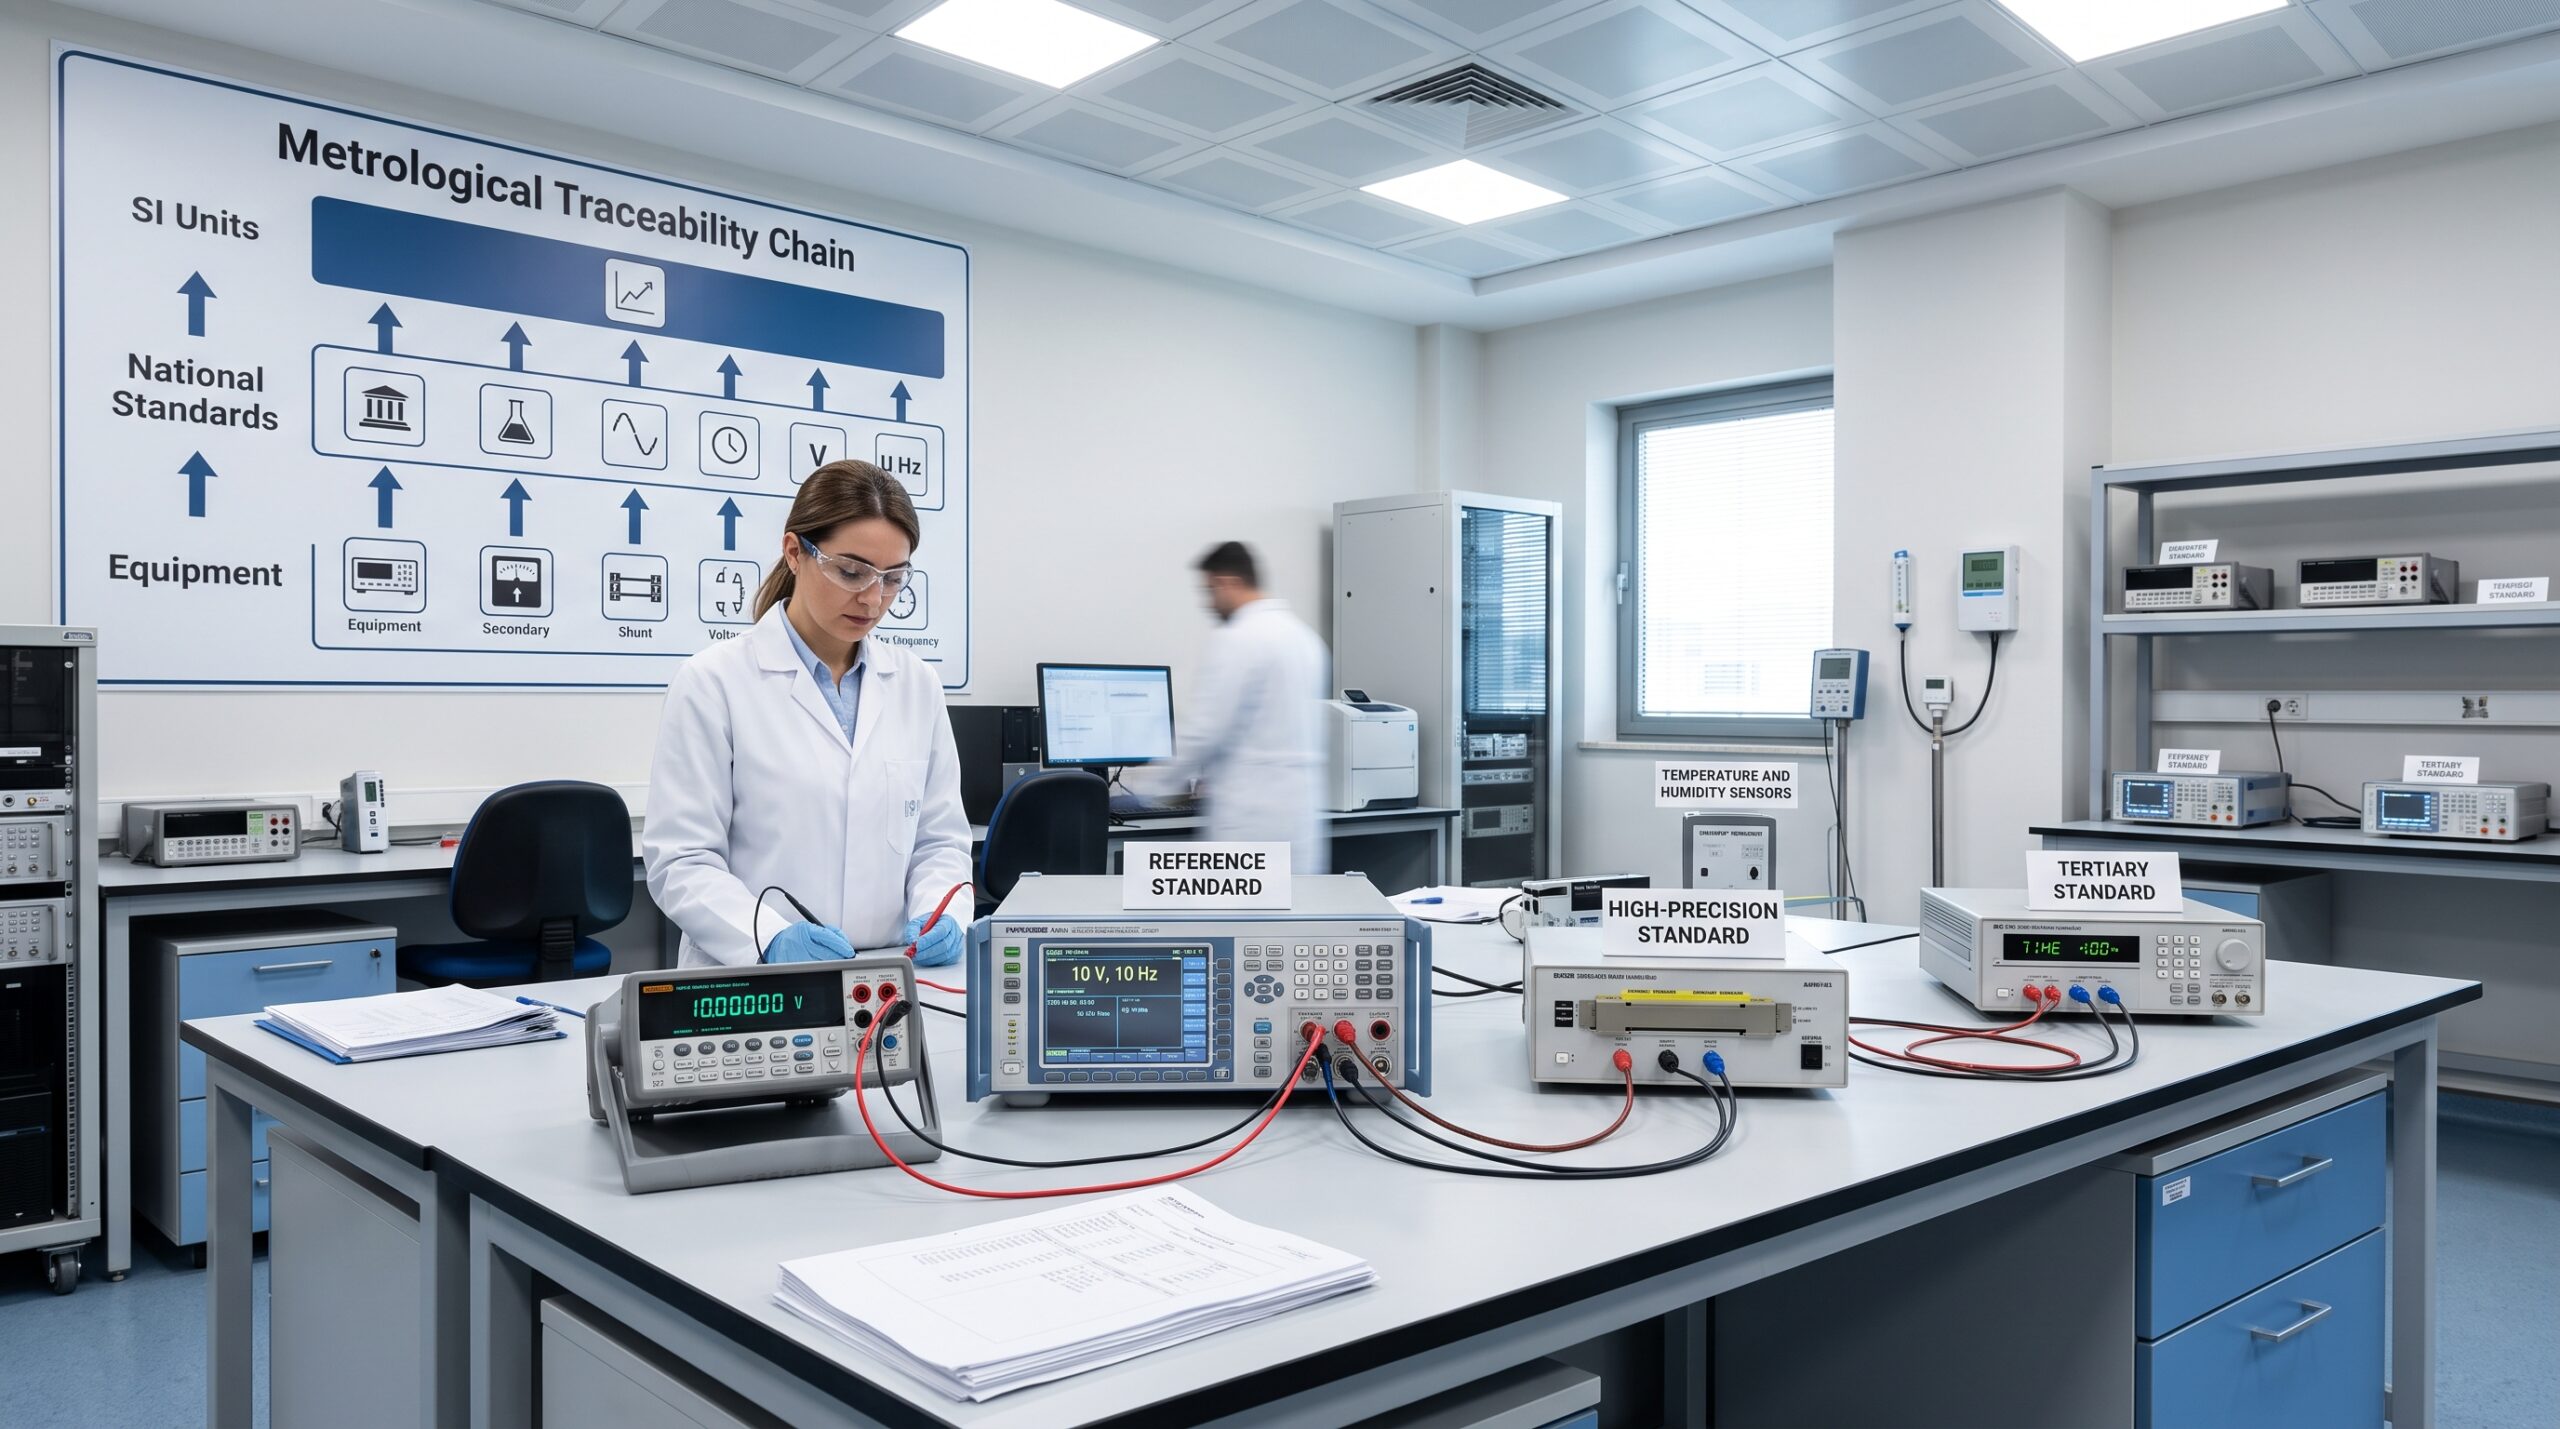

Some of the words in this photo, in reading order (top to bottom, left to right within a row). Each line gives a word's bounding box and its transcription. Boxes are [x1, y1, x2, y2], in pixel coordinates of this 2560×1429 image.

[278, 123, 543, 209] Metrological
[554, 181, 758, 260] Traceability
[769, 227, 855, 271] Chain
[131, 196, 162, 225] SI
[175, 202, 260, 241] Units
[128, 353, 263, 392] National
[112, 391, 279, 431] Standards
[809, 444, 827, 467] V
[109, 554, 283, 590] Equipment
[348, 618, 422, 634] Equipment
[482, 622, 550, 639] Secondary
[618, 626, 653, 639] Shunt
[1661, 769, 1759, 782] TEMPERATURE
[1762, 770, 1791, 782] AND
[1660, 786, 1726, 799] HUMIDITY
[1729, 786, 1792, 800] SENSORS
[1149, 852, 1266, 870] REFERENCE
[2057, 860, 2149, 877] TERTIARY
[1151, 878, 1262, 896] STANDARD
[2053, 883, 2156, 900] STANDARD
[1608, 900, 1778, 920] HIGH-PRECISION
[1637, 926, 1750, 945] STANDARD
[1072, 966, 1091, 982] 10
[1115, 965, 1134, 982] 10
[1138, 965, 1158, 981] Hz
[693, 993, 784, 1018] 10.00000
[794, 995, 803, 1010] V
